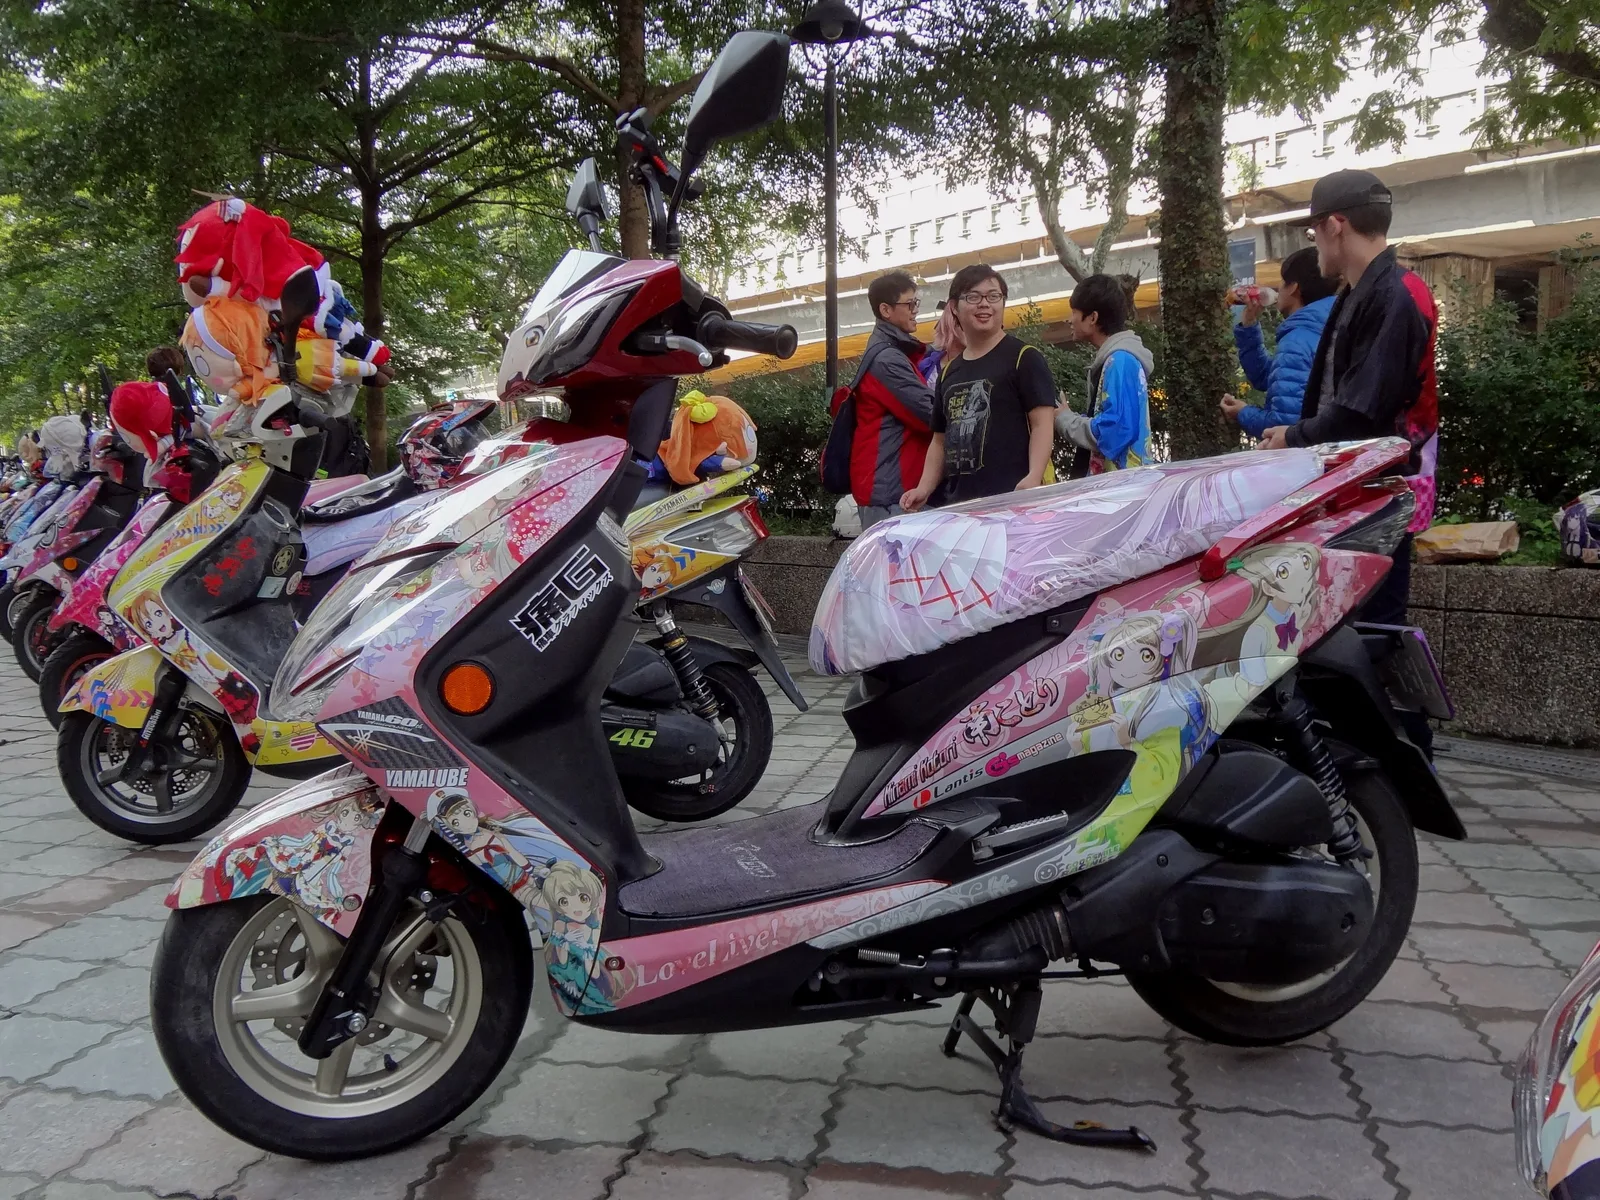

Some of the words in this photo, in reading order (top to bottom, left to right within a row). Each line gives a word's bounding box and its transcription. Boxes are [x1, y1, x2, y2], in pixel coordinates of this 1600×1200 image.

[662, 494, 688, 512] YAMAHA
[357, 710, 385, 722] YAMAHA
[609, 727, 657, 748] 46
[933, 767, 984, 799] Lantis
[1016, 732, 1065, 761] magazine
[386, 767, 470, 788] YAMALUBE
